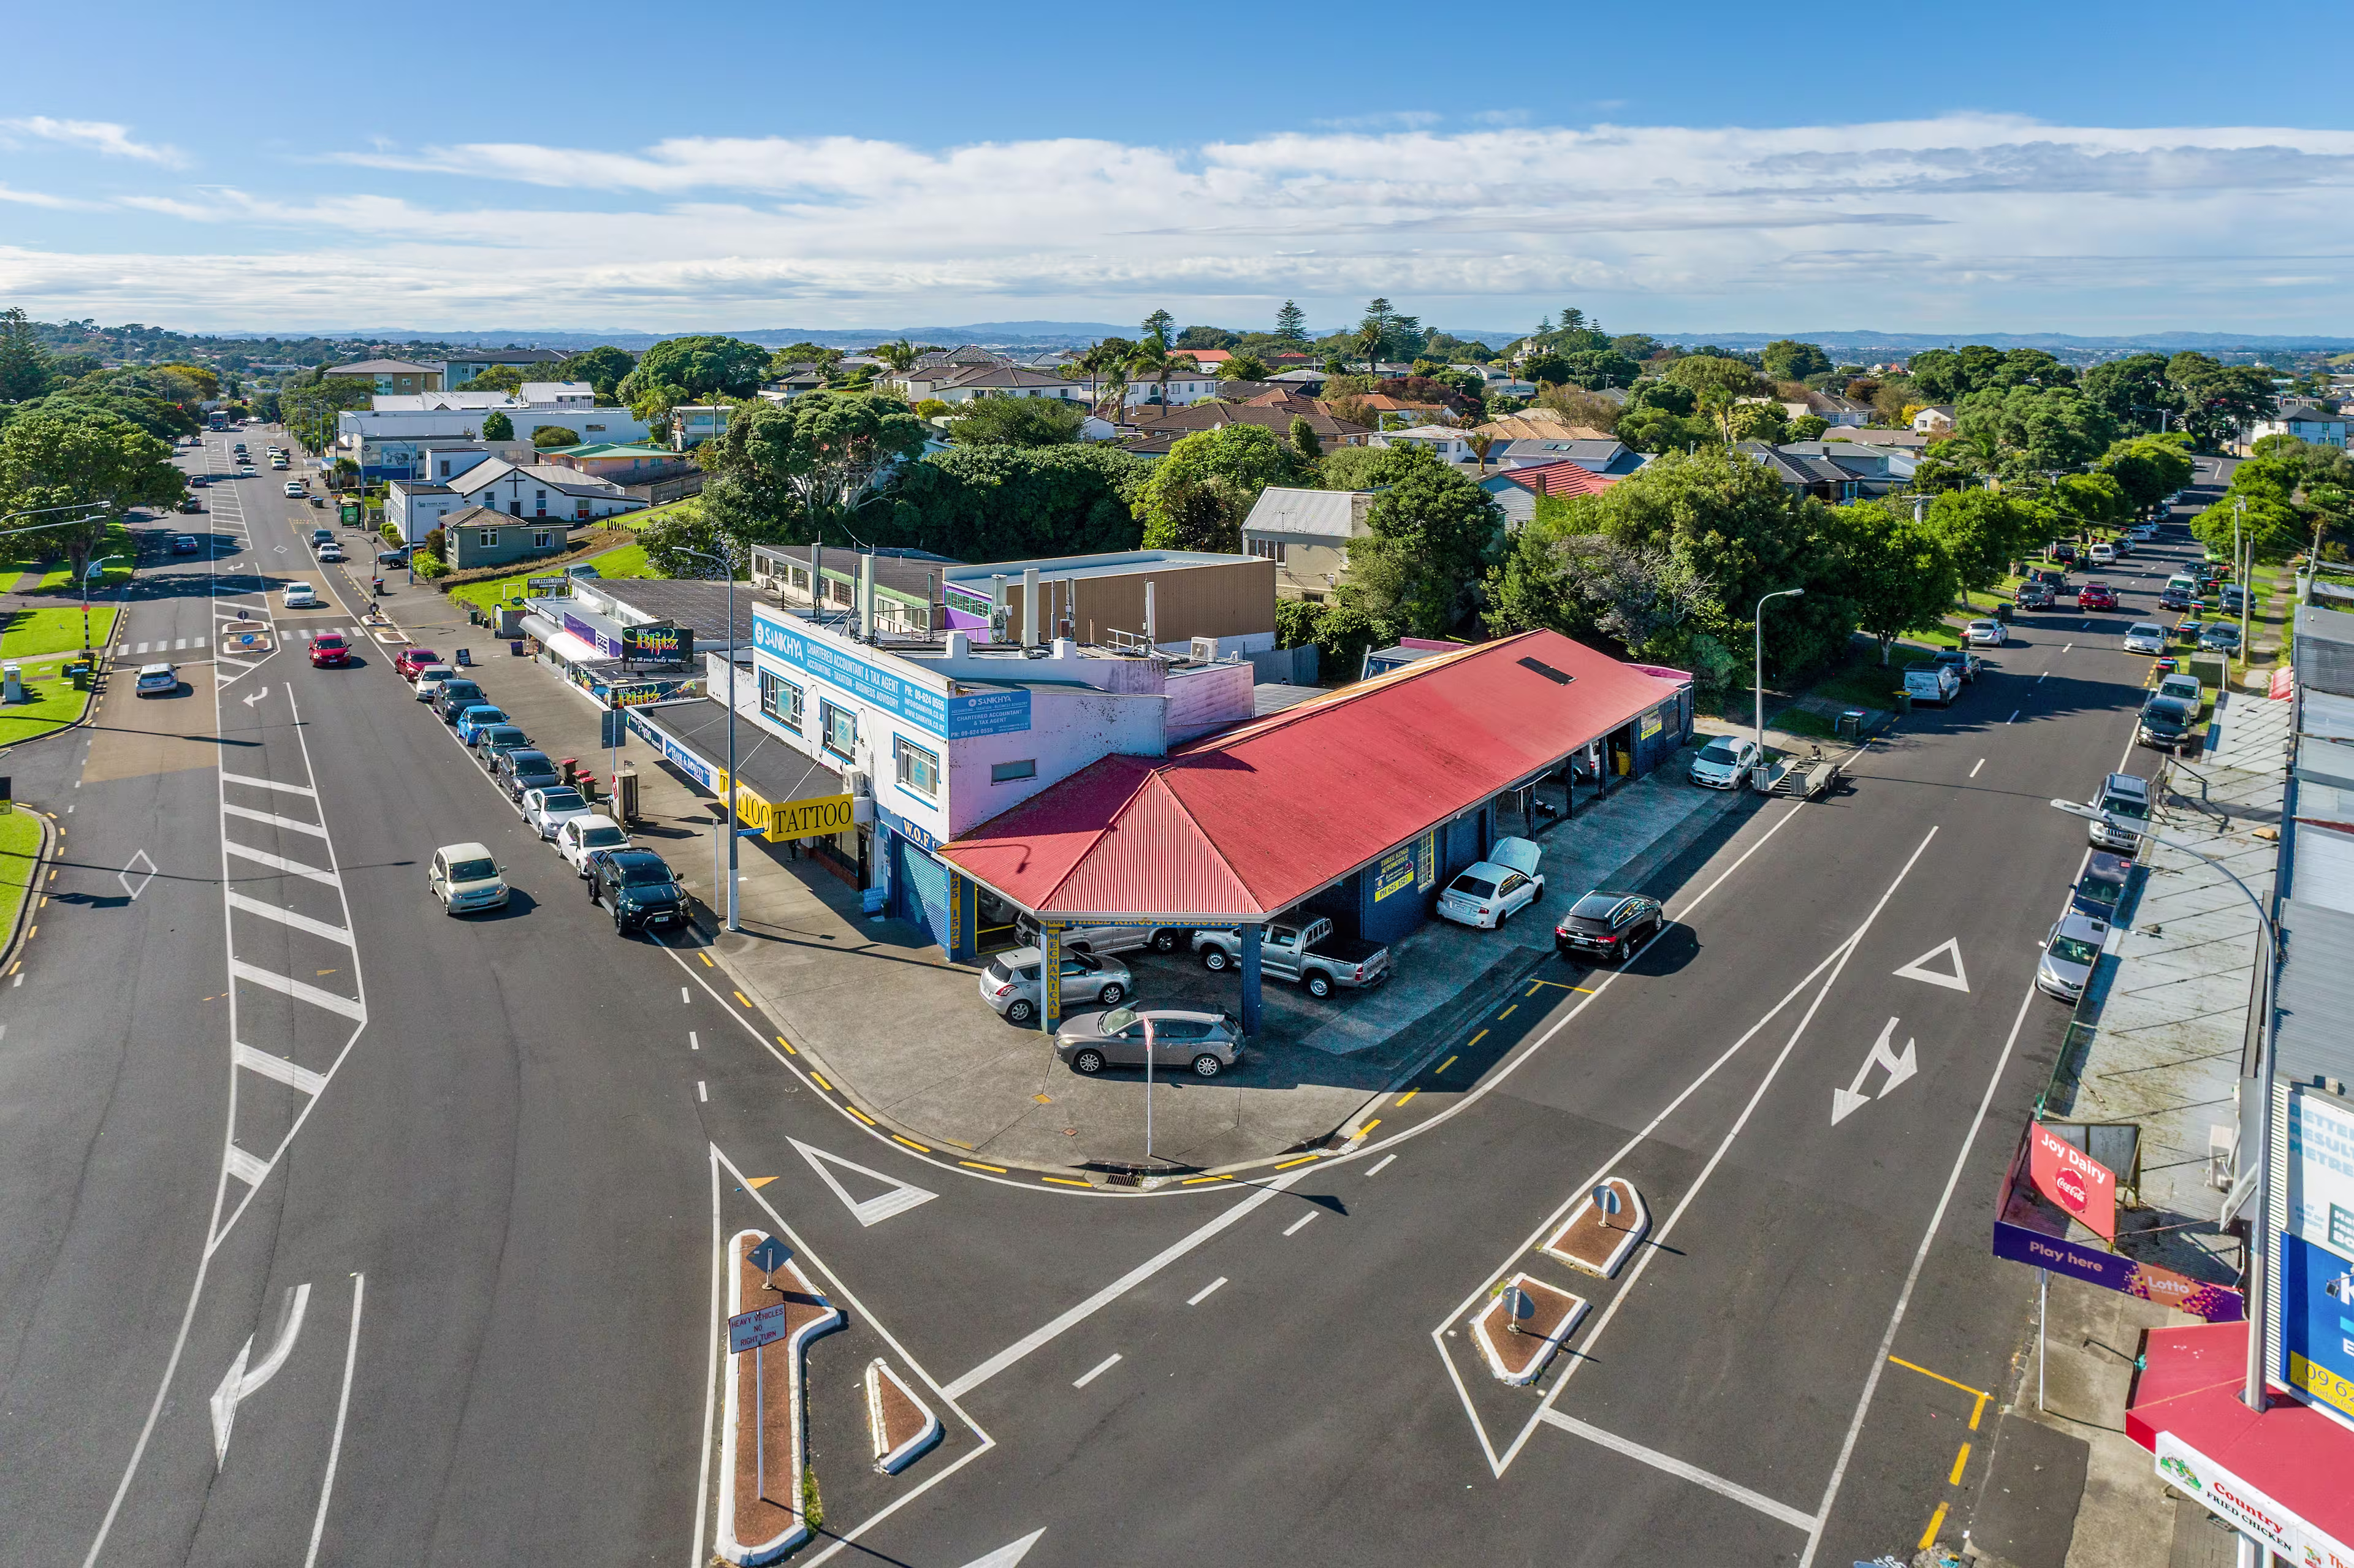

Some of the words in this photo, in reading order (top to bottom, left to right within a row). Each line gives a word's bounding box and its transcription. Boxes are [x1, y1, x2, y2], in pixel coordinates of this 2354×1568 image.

[634, 628, 679, 655] Blitz
[764, 626, 804, 661] SANKHYA
[807, 641, 833, 664] CHARTERED
[833, 653, 864, 679] ACCOUNTANT
[865, 668, 869, 681] &
[870, 670, 881, 686] TAX
[881, 674, 899, 695] AGENT
[617, 684, 661, 709] Blitz
[807, 658, 831, 677] ACCOUNTING
[834, 671, 853, 688] TAXATION
[855, 680, 876, 700] BUSINESS
[876, 691, 899, 709] ADVISORY
[904, 684, 913, 698] PH:
[914, 688, 932, 706] 09-624
[932, 697, 945, 712] 0555
[904, 697, 945, 722] INFO@SANKHYA.CO.NZ
[977, 695, 1012, 706] SANKHYA
[904, 707, 945, 733] WWW.SANKHYA.CO.NZ
[989, 709, 1023, 718] ACCOUNTANT
[671, 747, 683, 766] HAIR
[684, 755, 687, 766] &
[687, 758, 704, 779] BEAUTY
[720, 774, 770, 832] TTTOO
[774, 801, 851, 834] TATTOO
[904, 819, 930, 848] W.O.F
[1381, 853, 1396, 867] THREE
[1395, 847, 1409, 860] KINGS
[1381, 854, 1408, 875] AUTOMOTIVE
[951, 871, 959, 899] 625
[1380, 888, 1387, 898] PH
[1048, 932, 1059, 1016] MECHANICAL
[2041, 1133, 2065, 1158] Joy
[2069, 1149, 2106, 1184] Dairy
[2030, 1241, 2064, 1262] Play
[2067, 1252, 2104, 1273] here
[2147, 1275, 2190, 1294] Lotto
[731, 1316, 752, 1329] HEAVY
[754, 1308, 783, 1322] VEHICLES
[753, 1324, 763, 1333] NO
[741, 1335, 758, 1347] RIGHT
[760, 1330, 777, 1341] TURN
[2305, 1363, 2329, 1386] 09
[2296, 1376, 2310, 1386] call
[2313, 1385, 2339, 1404] today
[2207, 1490, 2239, 1517] FRIED
[2241, 1515, 2292, 1552] CHICKEN
[2214, 1482, 2284, 1534] Country
